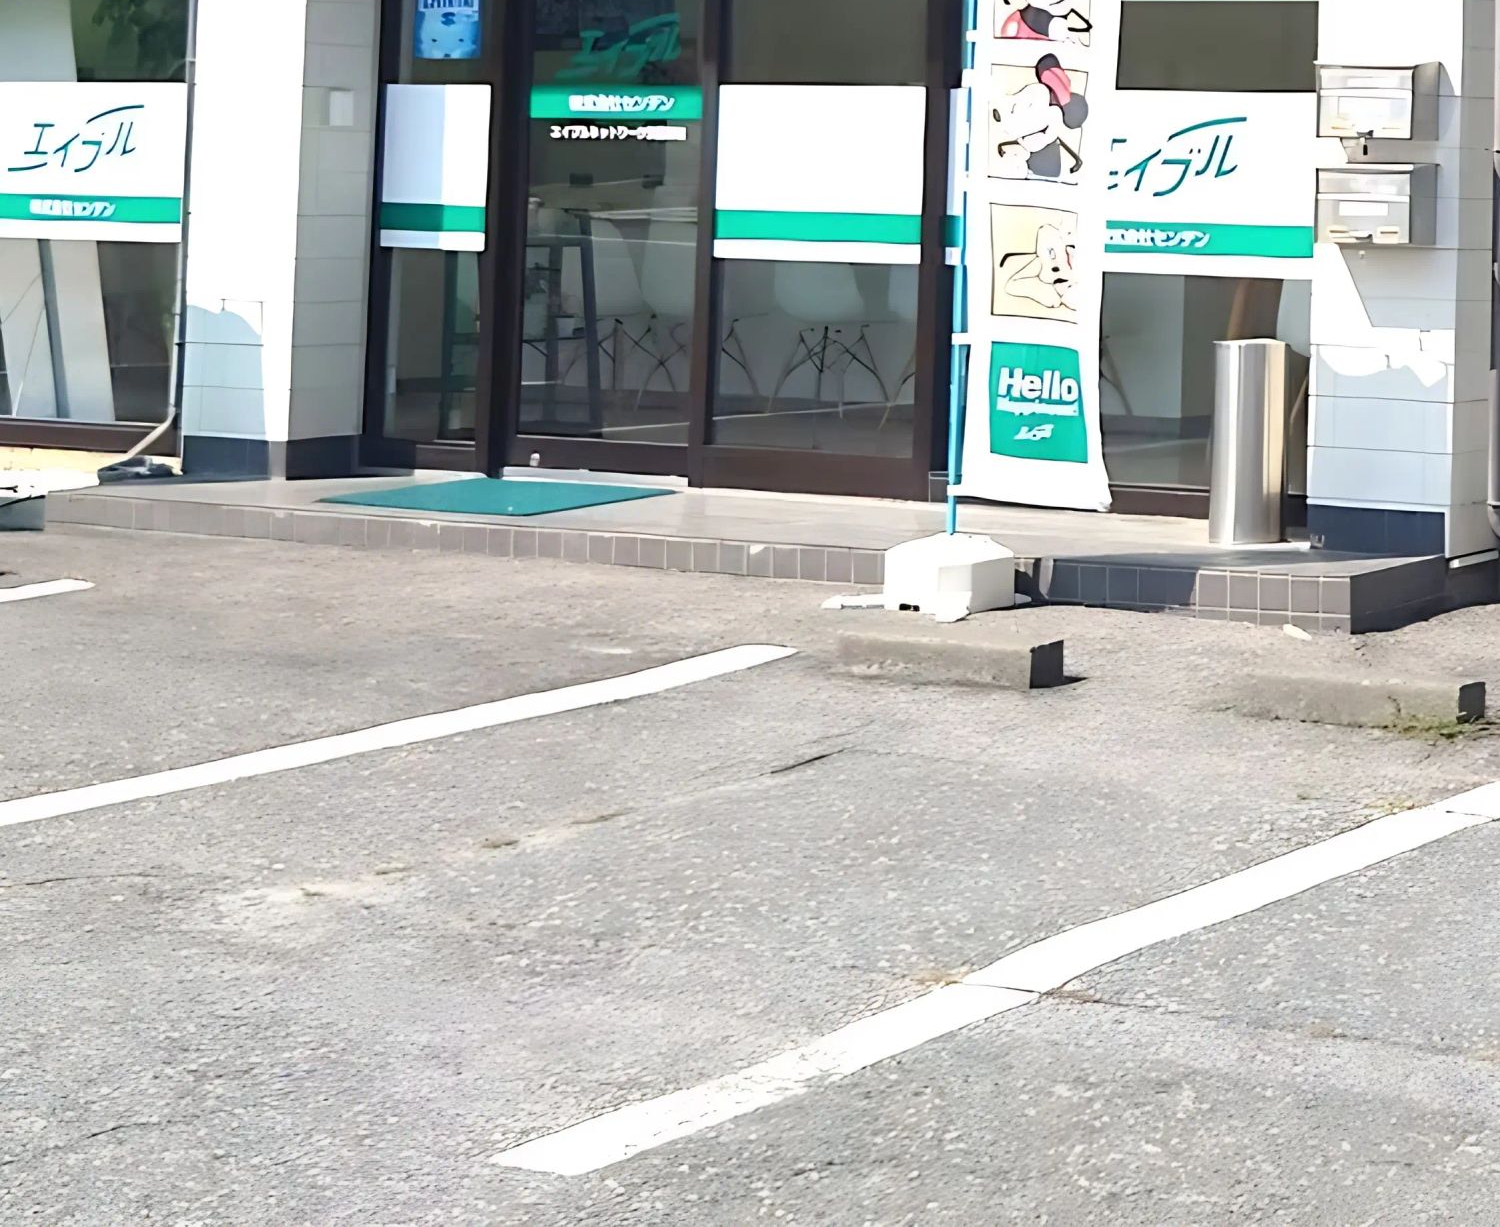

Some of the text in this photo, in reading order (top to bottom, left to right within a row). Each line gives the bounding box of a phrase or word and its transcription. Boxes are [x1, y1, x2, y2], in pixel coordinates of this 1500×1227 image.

[7, 104, 145, 173] エイブル
[997, 366, 1079, 402] Hello
